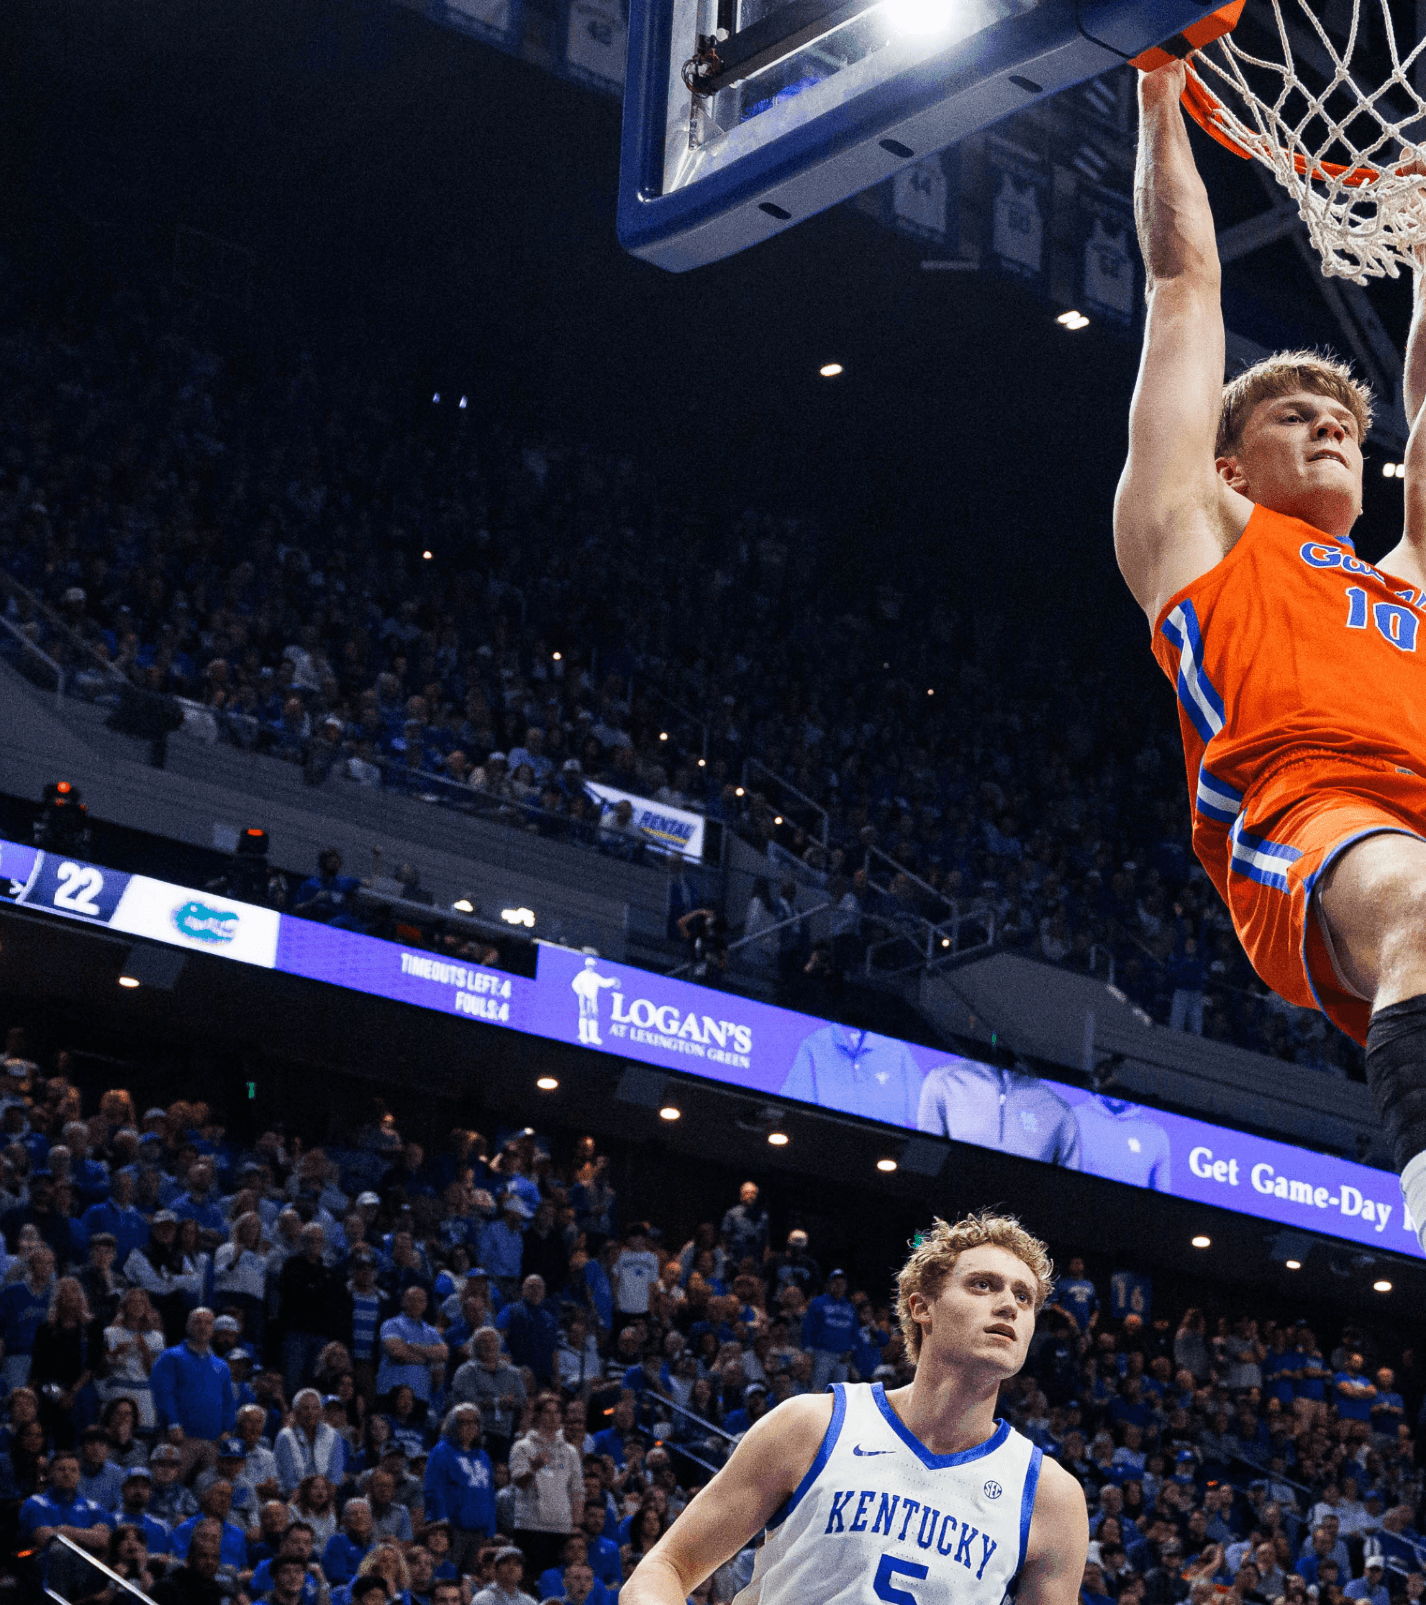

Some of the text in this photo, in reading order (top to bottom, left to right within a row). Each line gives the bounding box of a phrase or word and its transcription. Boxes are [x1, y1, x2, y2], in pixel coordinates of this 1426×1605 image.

[1346, 586, 1420, 652] 10
[54, 863, 104, 915] 22
[401, 953, 467, 988] TIMEOUTS
[609, 1023, 751, 1069] AT LEXINGTON GREEN
[610, 992, 752, 1054] LOGAN'S
[1189, 1146, 1240, 1187] Get
[1251, 1162, 1393, 1233] Game-Day
[984, 1480, 1002, 1499] SEC
[825, 1491, 998, 1581] KENTUCKY
[873, 1553, 930, 1605] 5
